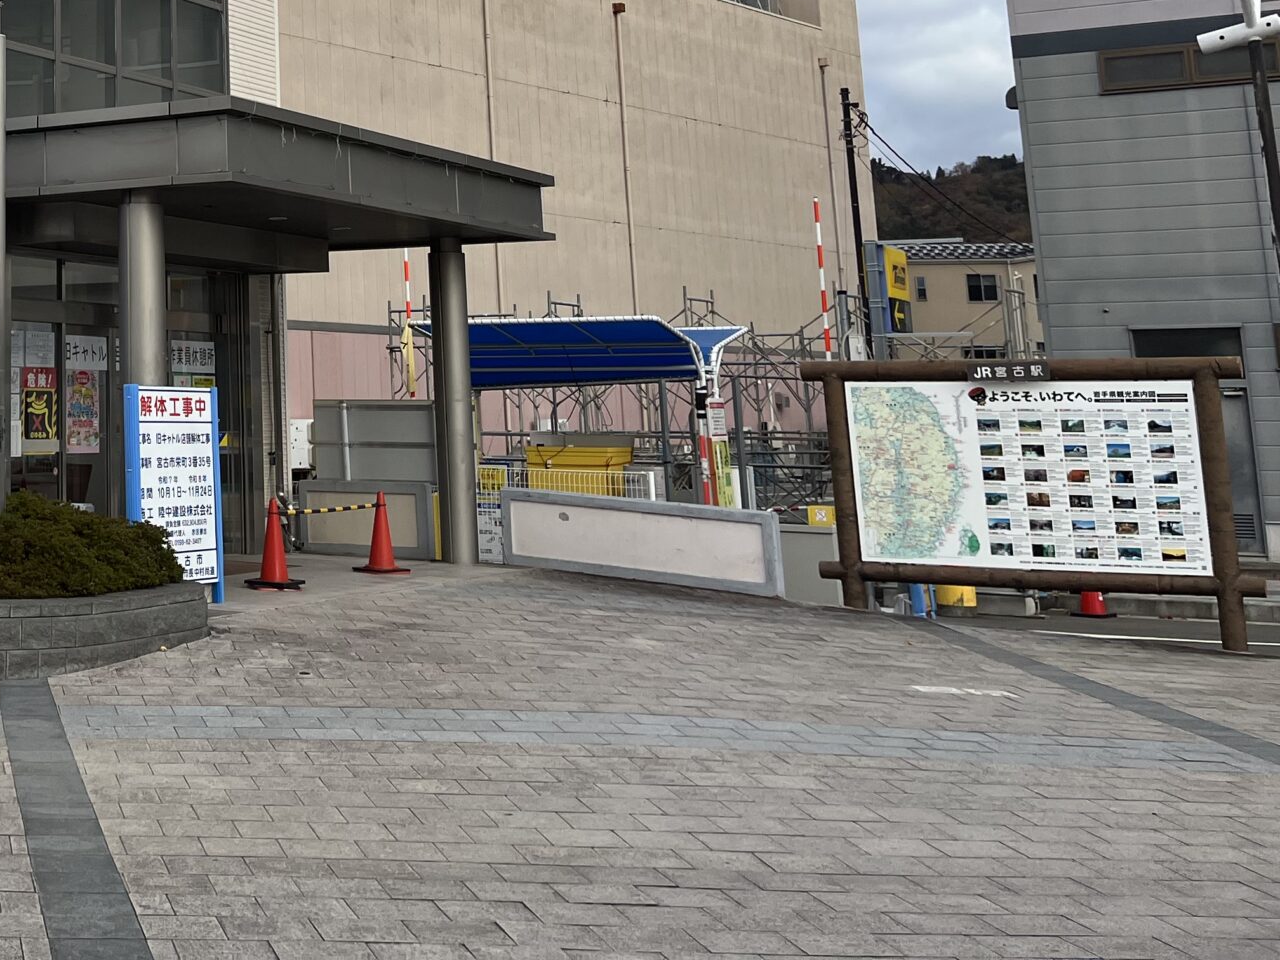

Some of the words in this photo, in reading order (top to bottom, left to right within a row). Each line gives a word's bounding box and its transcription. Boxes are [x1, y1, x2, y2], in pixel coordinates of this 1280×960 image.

[988, 390, 1093, 403] ようこそ、いわてへ。
[140, 395, 206, 417] 解体工事中
